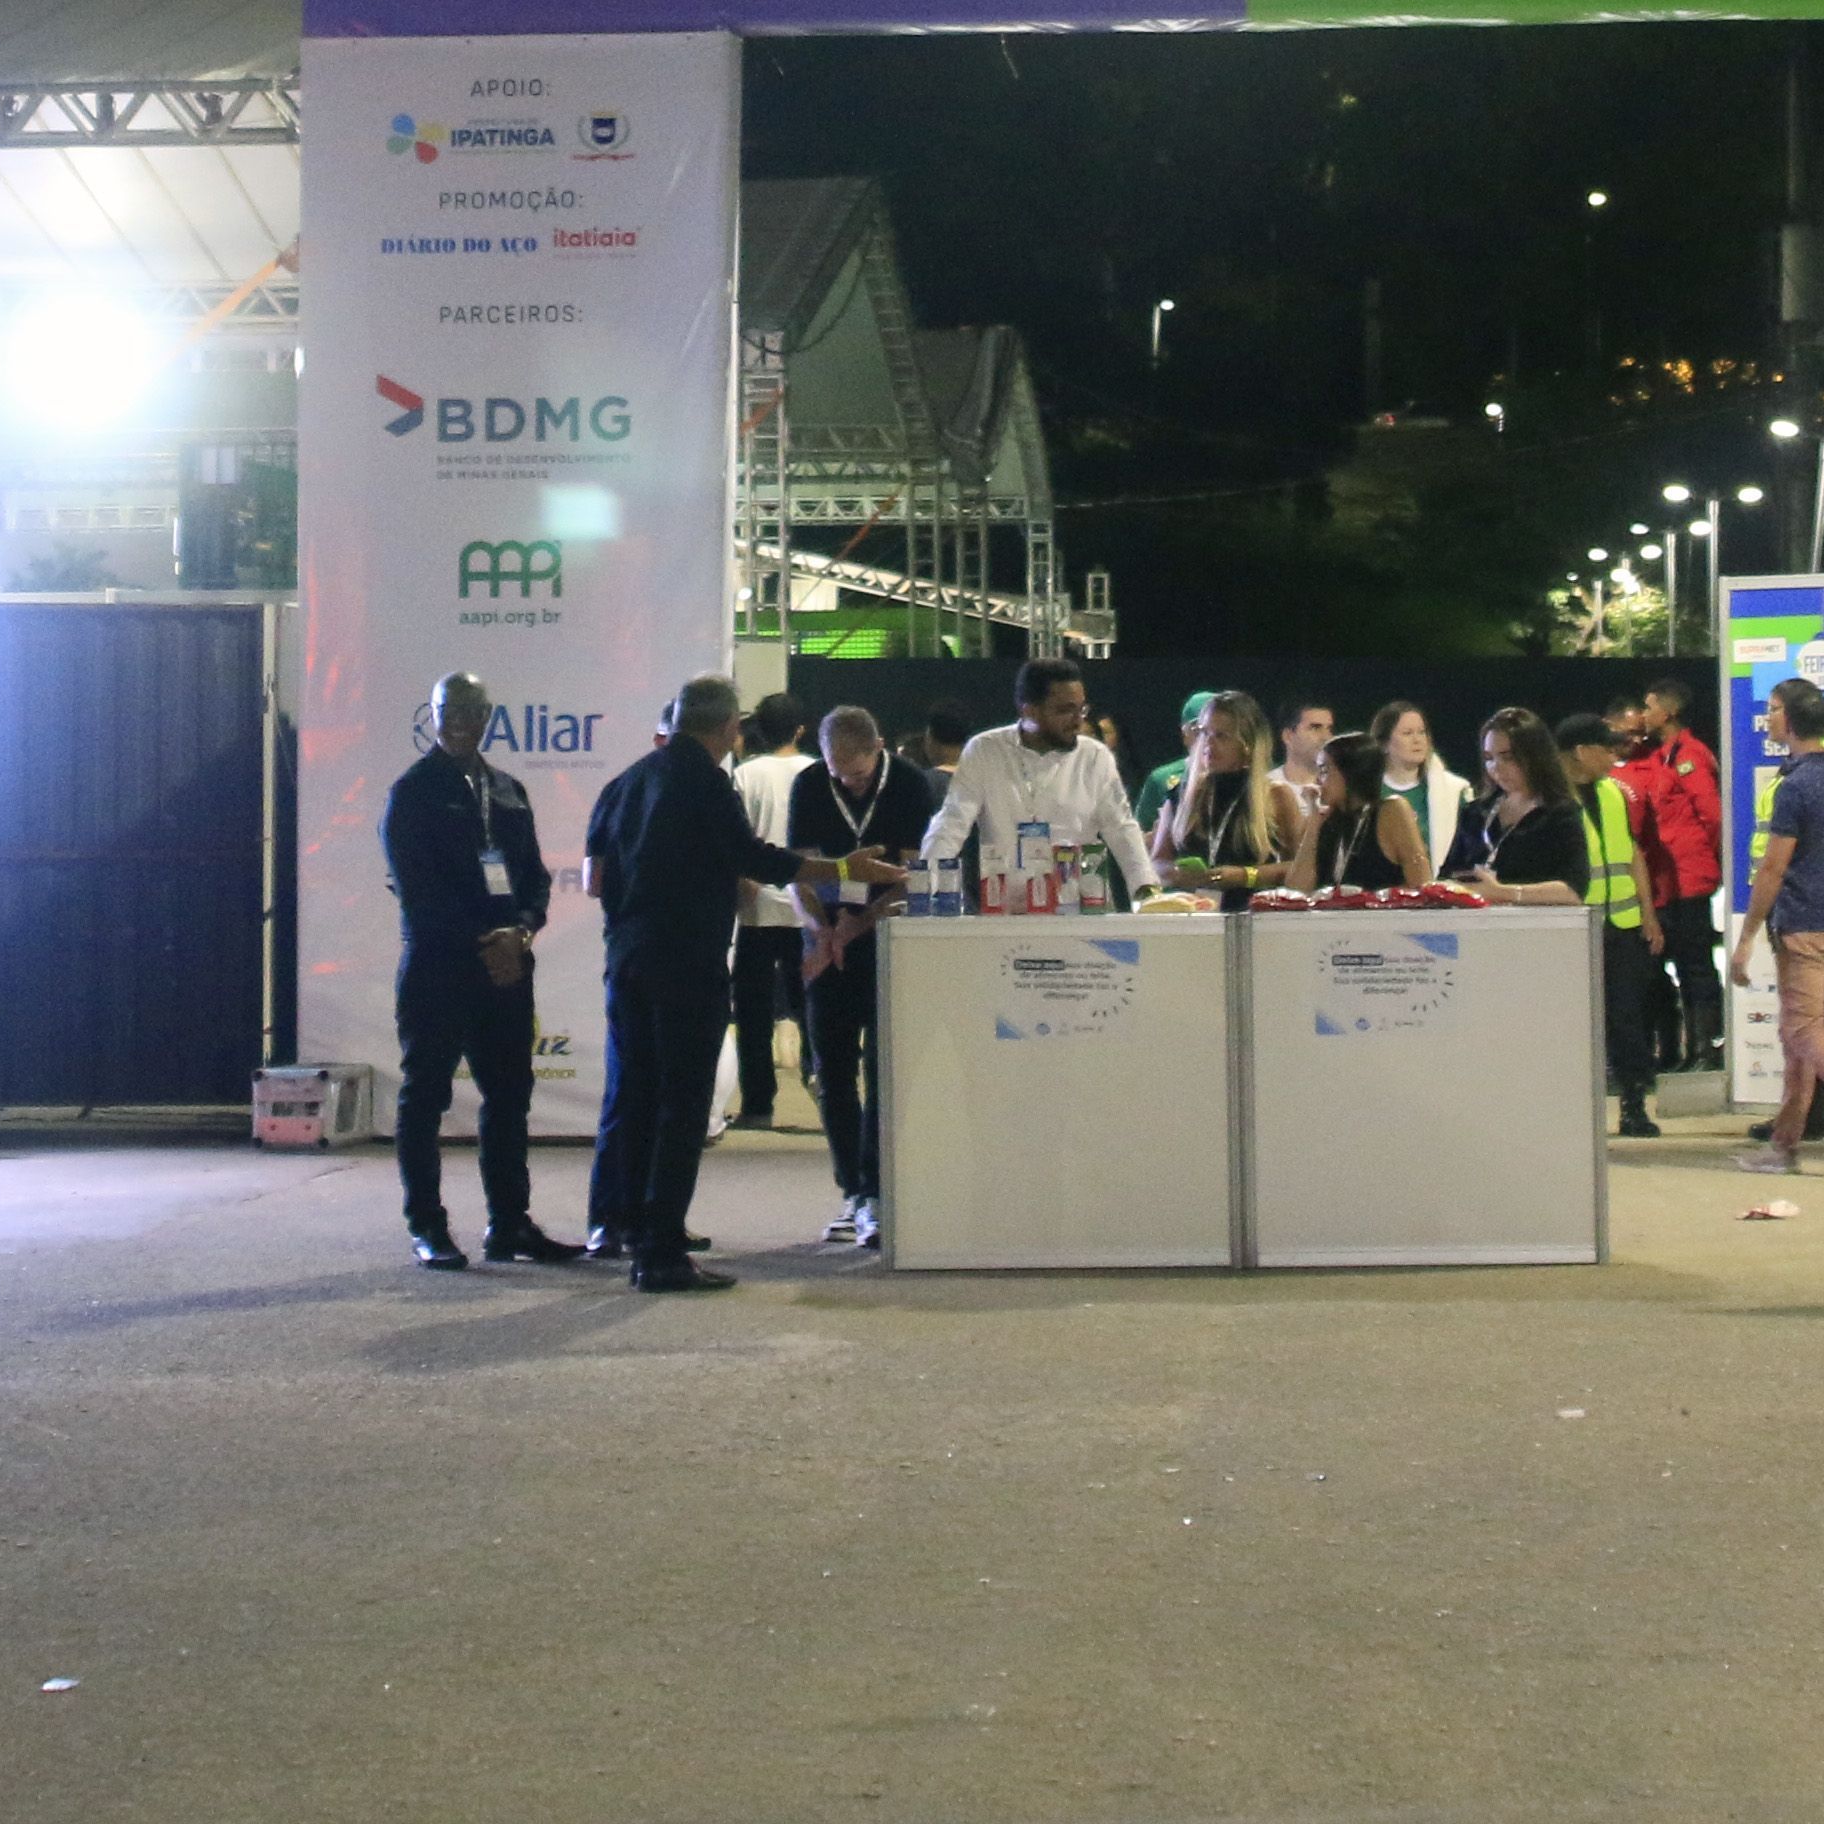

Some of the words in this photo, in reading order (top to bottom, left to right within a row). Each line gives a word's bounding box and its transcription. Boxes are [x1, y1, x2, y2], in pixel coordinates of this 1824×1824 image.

[470, 78, 551, 98] APOIO:
[450, 128, 556, 147] IPATINGA
[438, 190, 584, 213] PROMOÇÃO:
[381, 234, 456, 254] DIÁRIO
[462, 237, 491, 253] DO
[499, 236, 538, 256] AÇO
[553, 227, 637, 248] itatiaia
[438, 304, 583, 324] PARCEIROS:
[436, 394, 633, 444] BDMG
[459, 607, 562, 628] aapi.org.br
[479, 703, 604, 753] Aliar
